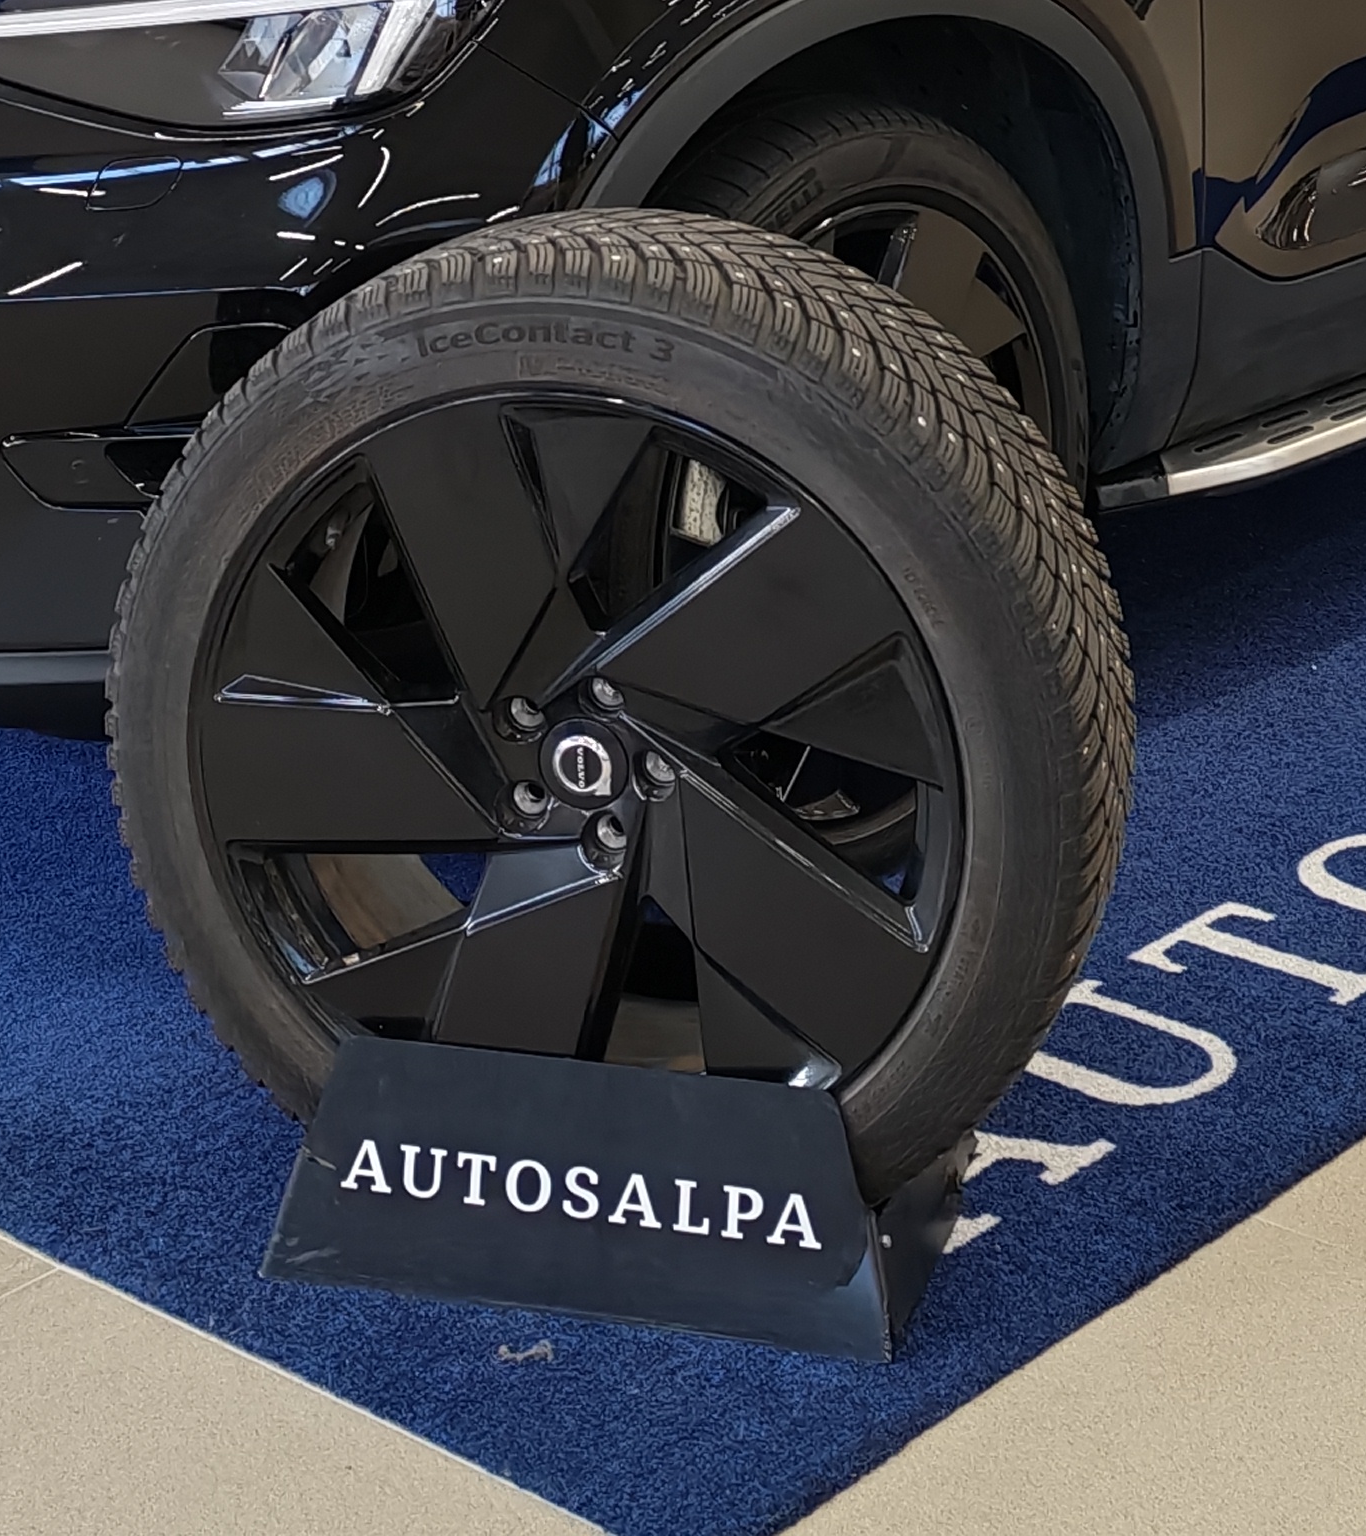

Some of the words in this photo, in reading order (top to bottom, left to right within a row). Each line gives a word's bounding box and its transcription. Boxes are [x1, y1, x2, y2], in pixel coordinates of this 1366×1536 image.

[418, 320, 637, 358] IceContact
[649, 337, 675, 364] 3
[576, 746, 587, 789] VOLVO
[340, 1139, 822, 1250] AUTOSALPA
